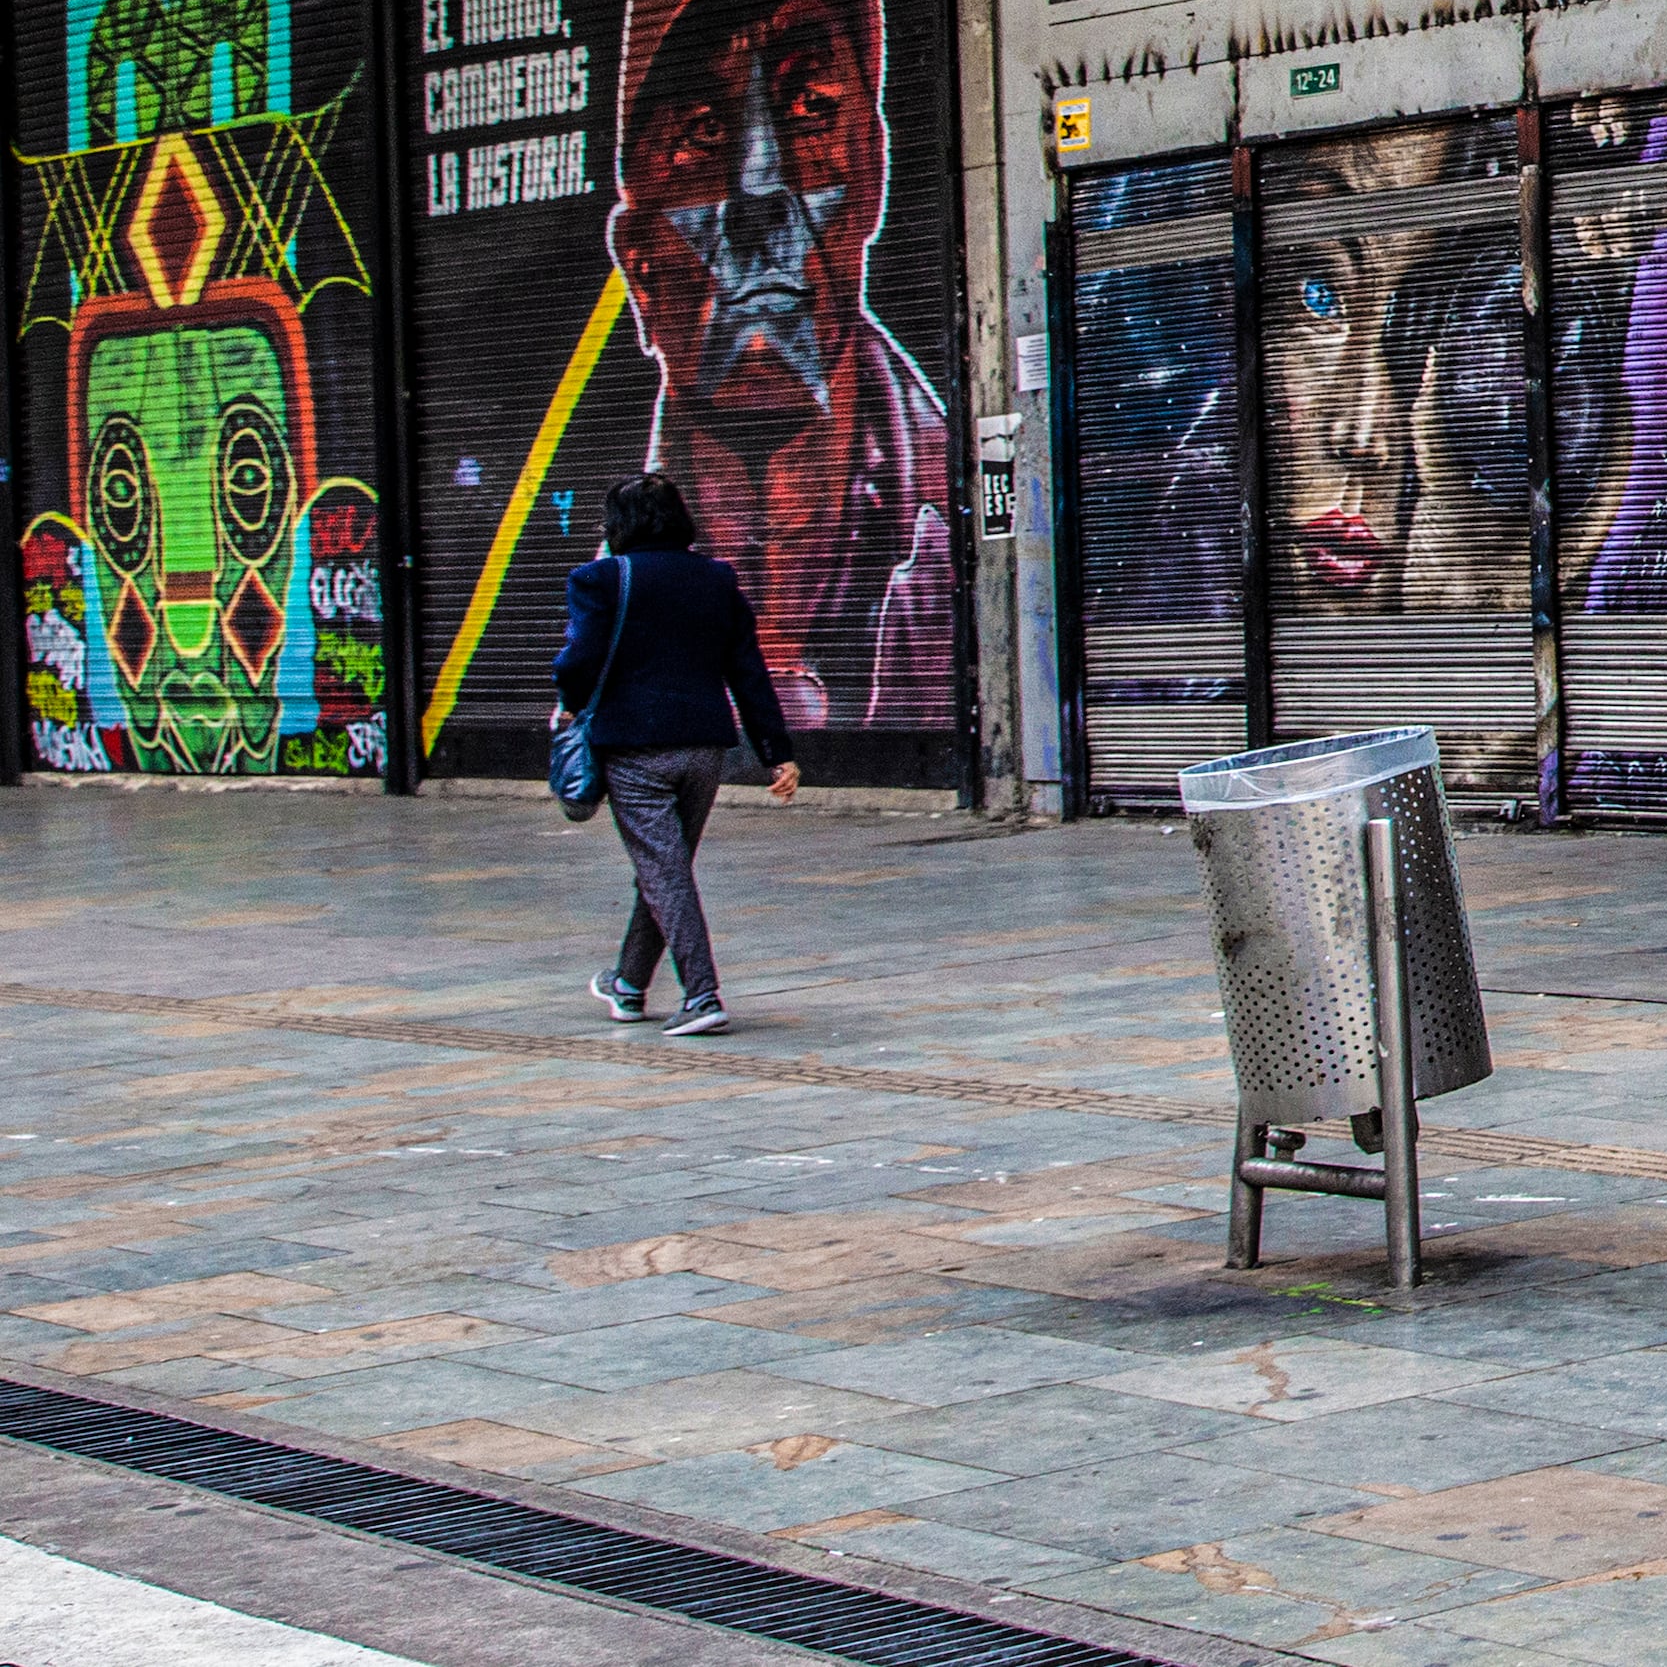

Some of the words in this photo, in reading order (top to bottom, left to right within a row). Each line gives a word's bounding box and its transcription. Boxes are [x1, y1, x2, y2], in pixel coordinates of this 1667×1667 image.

[424, 45, 590, 135] CAMBIEMOS
[427, 151, 461, 217] LA
[466, 130, 596, 212] HISTORIA.
